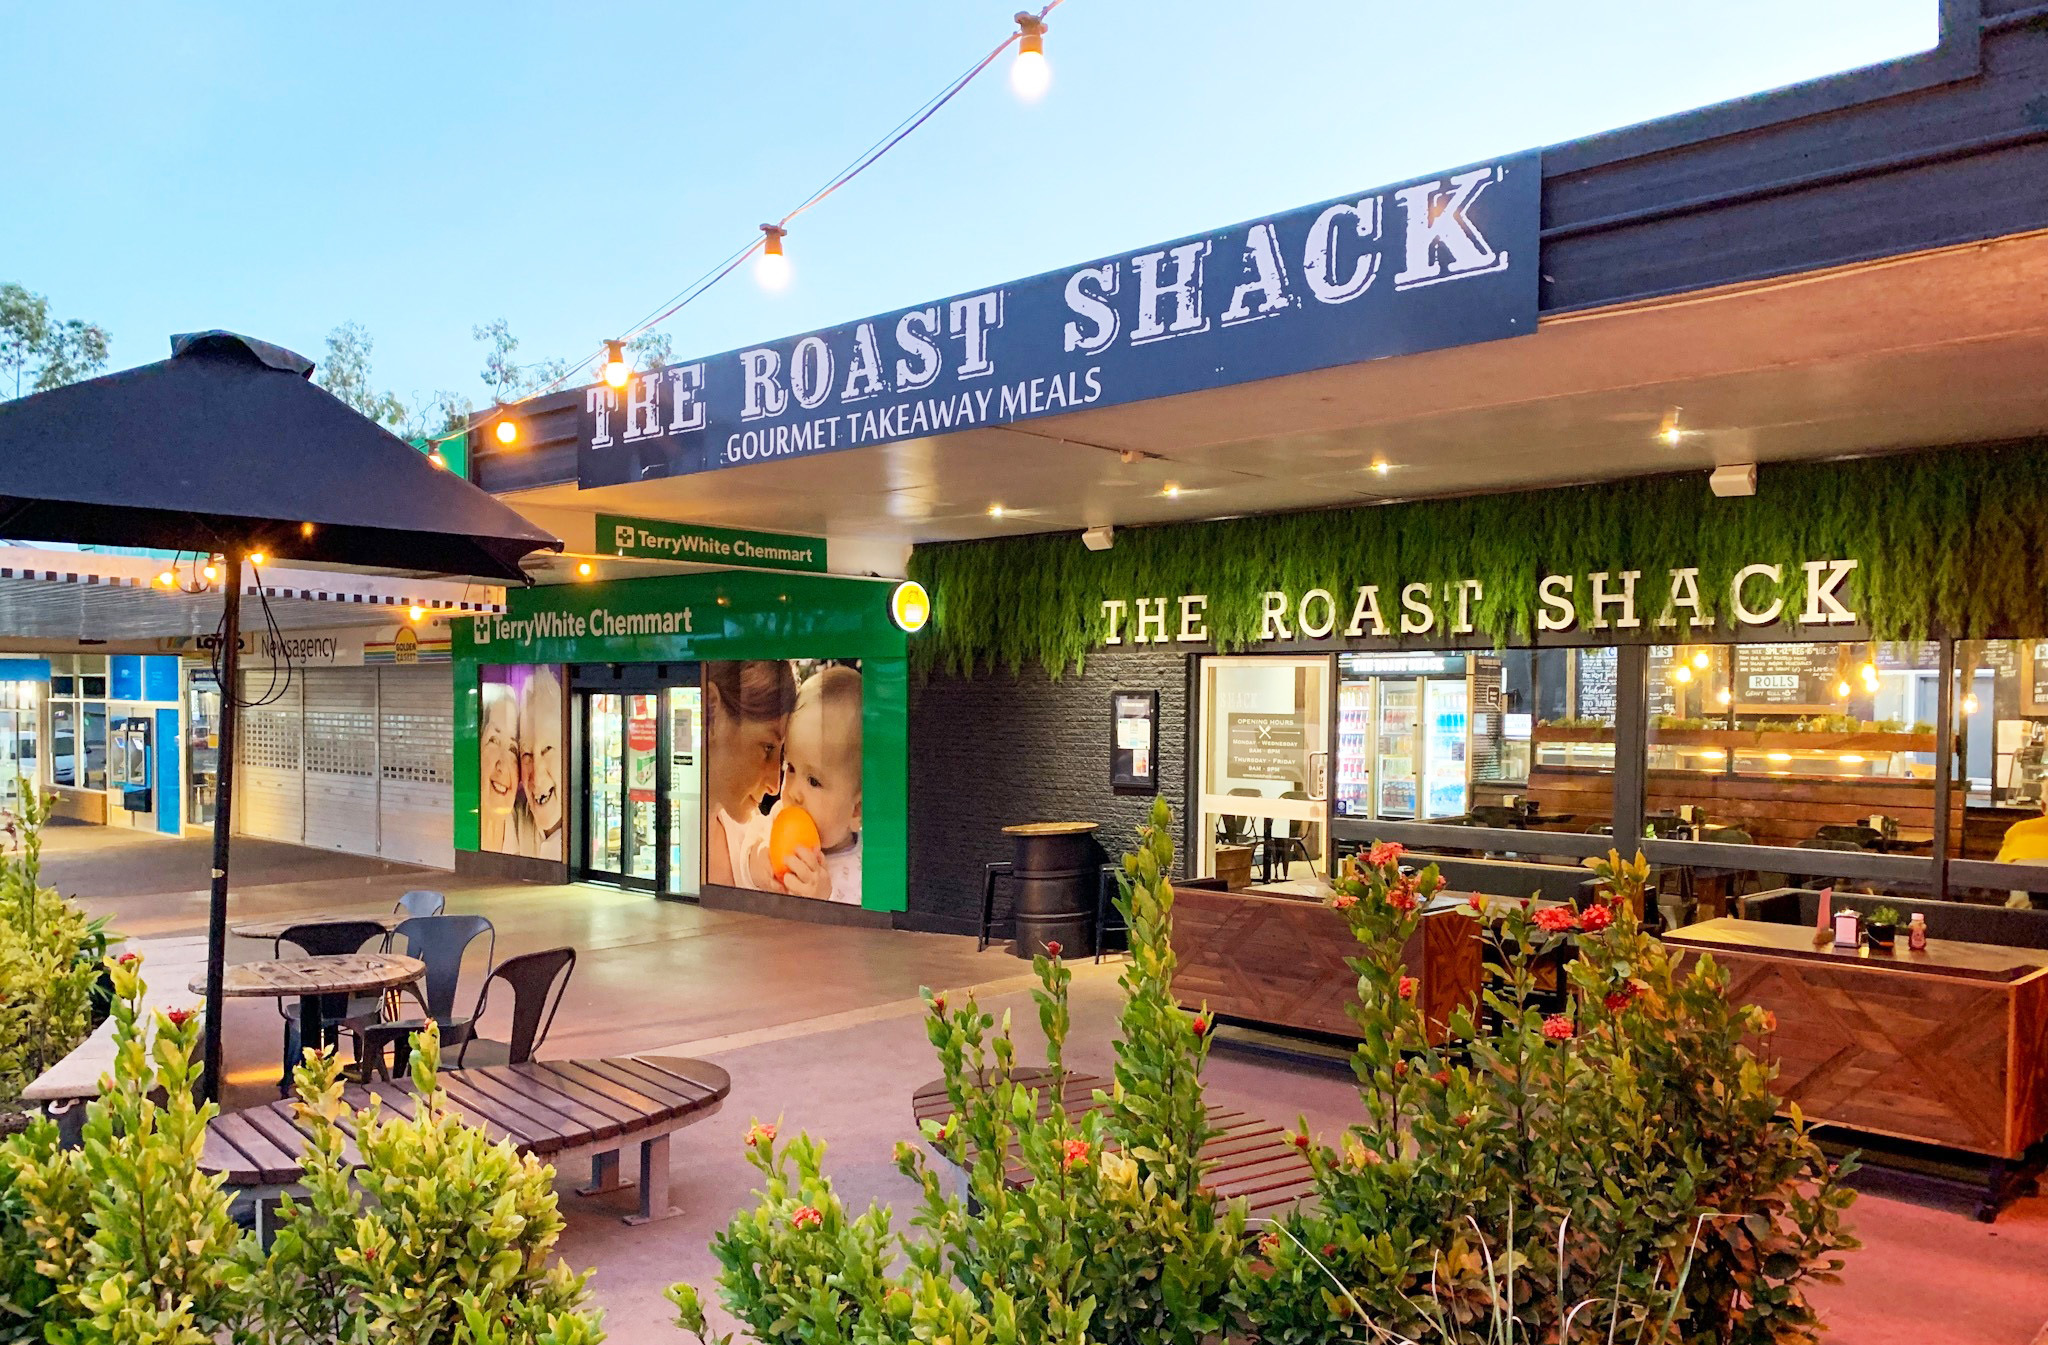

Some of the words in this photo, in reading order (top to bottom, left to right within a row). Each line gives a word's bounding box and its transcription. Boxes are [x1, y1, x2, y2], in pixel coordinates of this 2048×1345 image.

[586, 362, 706, 450] THE
[740, 290, 1005, 422] ROAST
[1064, 165, 1509, 356] SHACK
[727, 415, 840, 463] GOURMET
[847, 387, 993, 444] TAKEAWAY
[999, 366, 1102, 419] MEALS
[638, 530, 730, 555] TerryWhite
[733, 540, 813, 563] Chemmart
[1101, 594, 1208, 645] THE
[1259, 579, 1483, 640] ROAST
[1537, 559, 1858, 631] SHACK
[493, 610, 586, 647] TerryWhite
[589, 606, 693, 638] Chemmart
[261, 634, 338, 663] Newsagency
[1754, 676, 1795, 687] ROLLS
